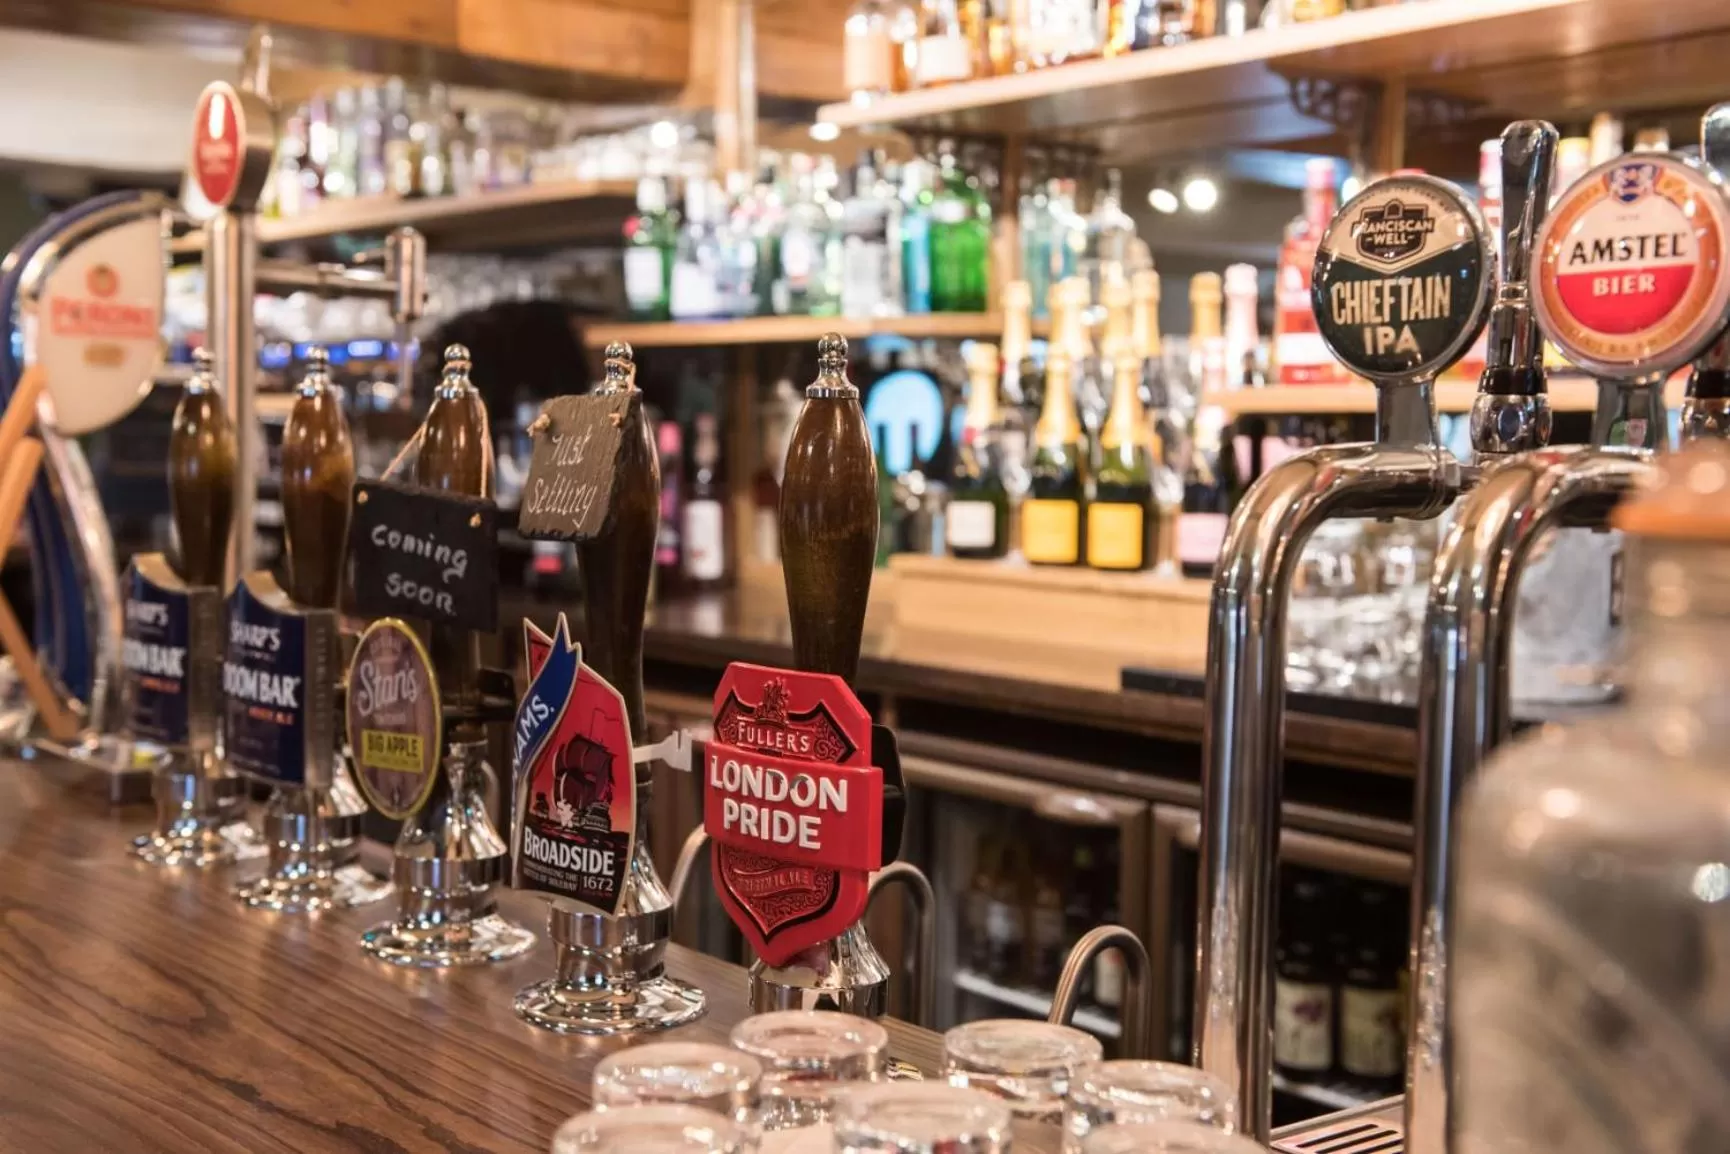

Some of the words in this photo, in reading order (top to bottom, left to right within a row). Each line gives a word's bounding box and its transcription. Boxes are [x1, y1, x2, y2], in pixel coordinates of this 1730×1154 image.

[1569, 234, 1684, 266] AMSTEL
[1332, 276, 1451, 325] CHIEFTAIN
[1593, 276, 1655, 297] BIER
[1363, 324, 1421, 355] IPA
[358, 659, 421, 717] Stan's
[386, 736, 420, 759] APPLE
[738, 720, 810, 753] FULLER'S
[710, 755, 849, 812] LONDON
[723, 798, 822, 850] PRIDE
[523, 826, 616, 876] BROADSIDE
[583, 876, 614, 892] 1672
